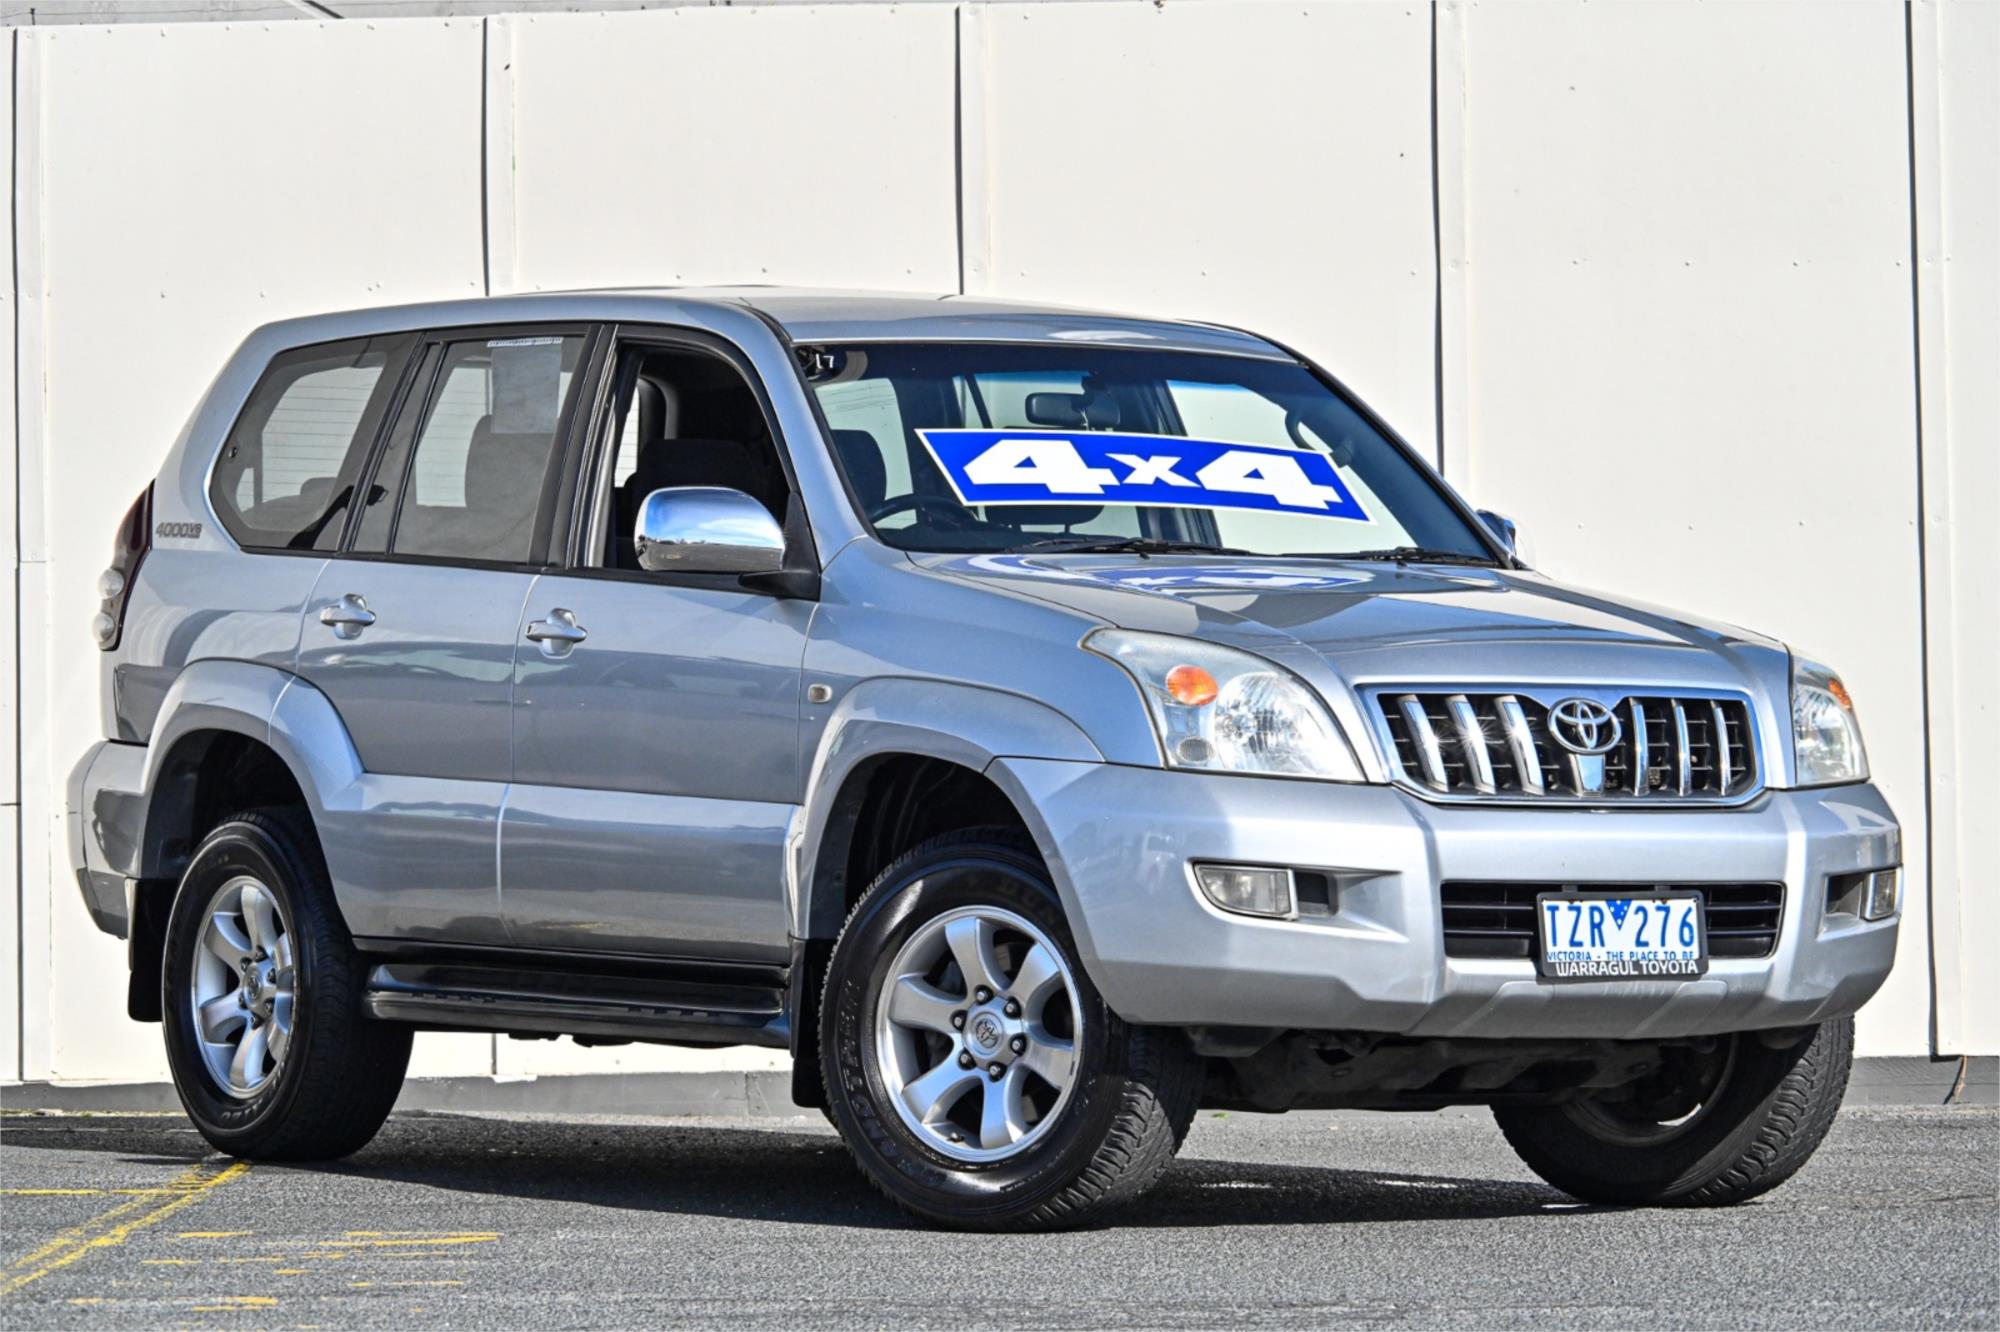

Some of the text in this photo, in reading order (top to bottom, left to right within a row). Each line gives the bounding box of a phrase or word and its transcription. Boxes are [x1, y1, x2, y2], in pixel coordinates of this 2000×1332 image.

[963, 439, 1343, 509] 4x4
[1546, 905, 1694, 947] TZR 276
[1546, 951, 1592, 961] VICTORIA
[1606, 951, 1624, 961] THE
[1629, 951, 1659, 961] PLACE
[1663, 951, 1677, 961] TO
[1682, 951, 1694, 960] BE
[1555, 960, 1699, 976] WARRAGUL TOYOTA
